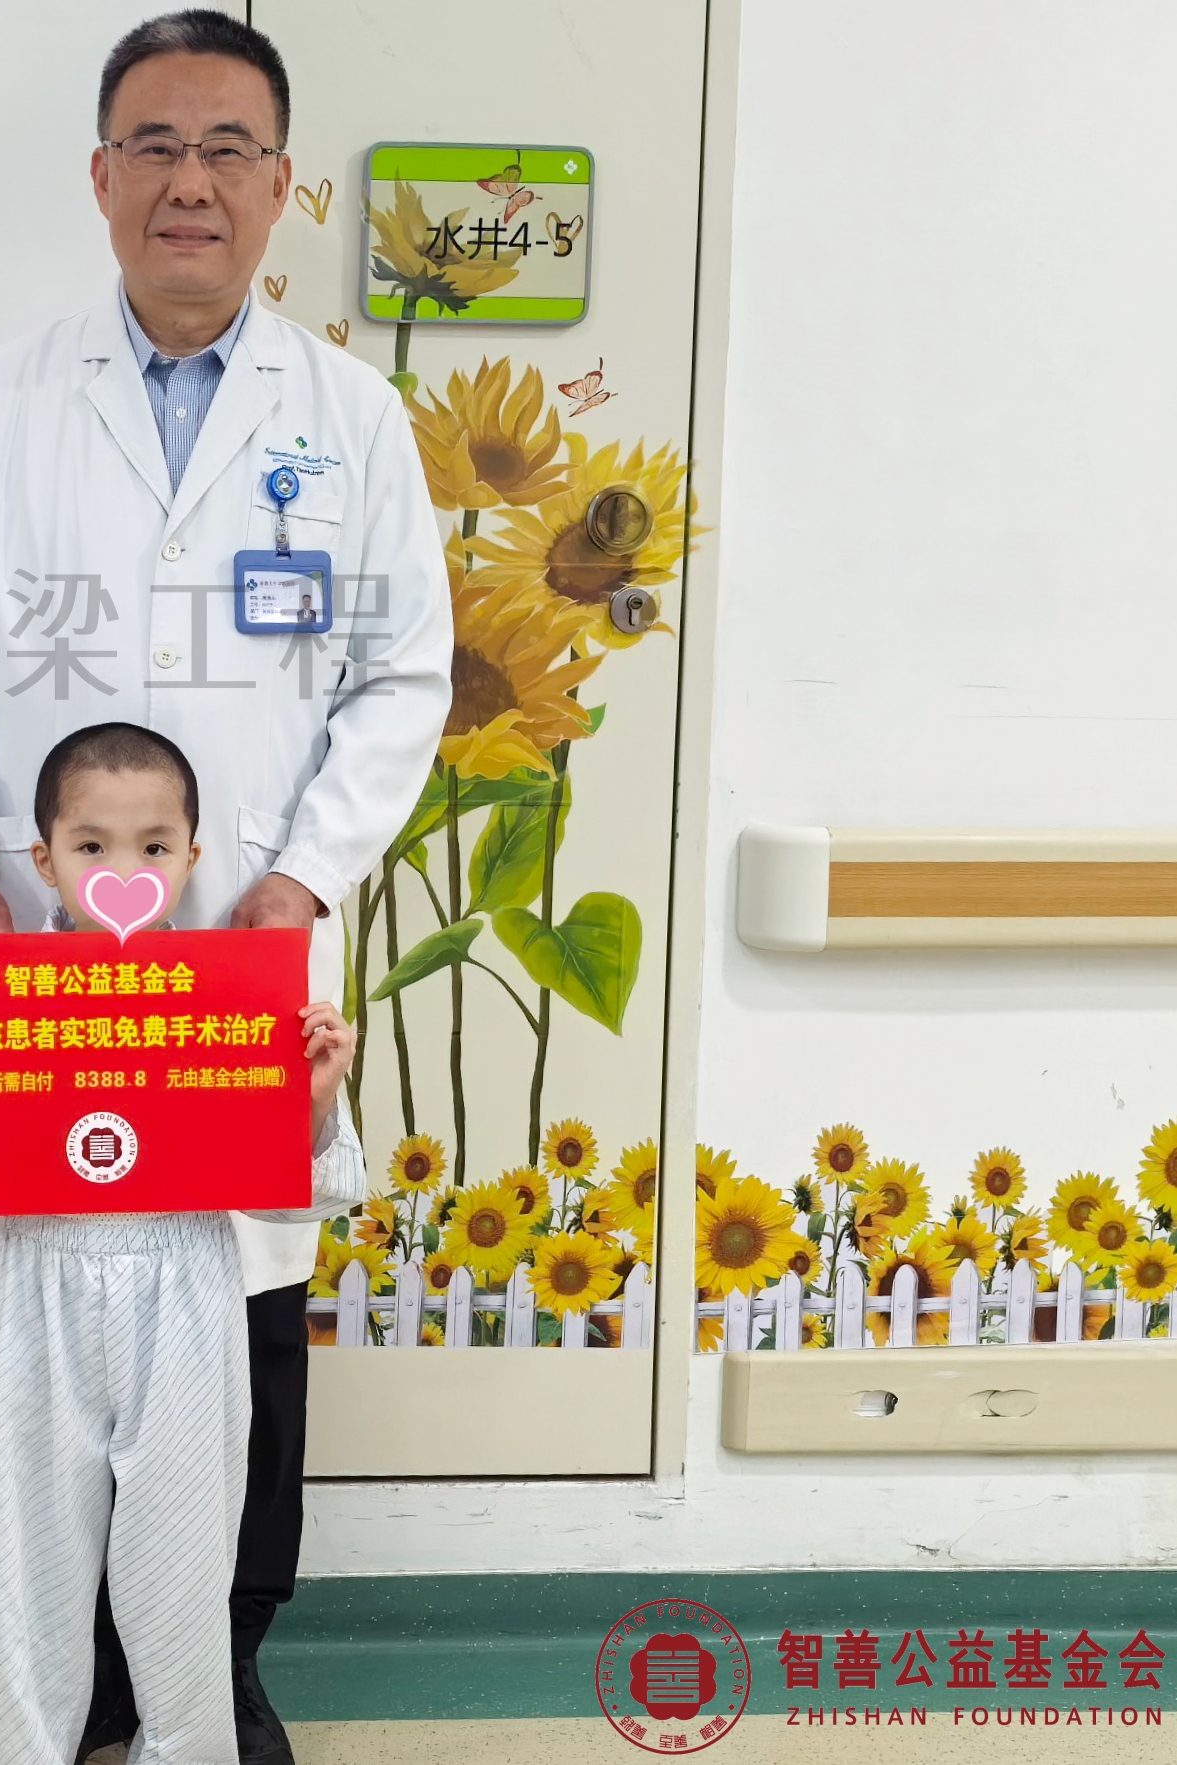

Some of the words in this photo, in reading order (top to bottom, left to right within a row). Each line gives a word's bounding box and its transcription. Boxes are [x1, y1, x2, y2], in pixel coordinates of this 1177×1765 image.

[425, 216, 573, 260] 水井4-5
[4, 961, 195, 997] 智善公益基金会
[74, 1070, 147, 1089] 8388.8
[68, 1117, 90, 1157] ZHISHAN
[93, 1113, 137, 1156] FOUNDATION
